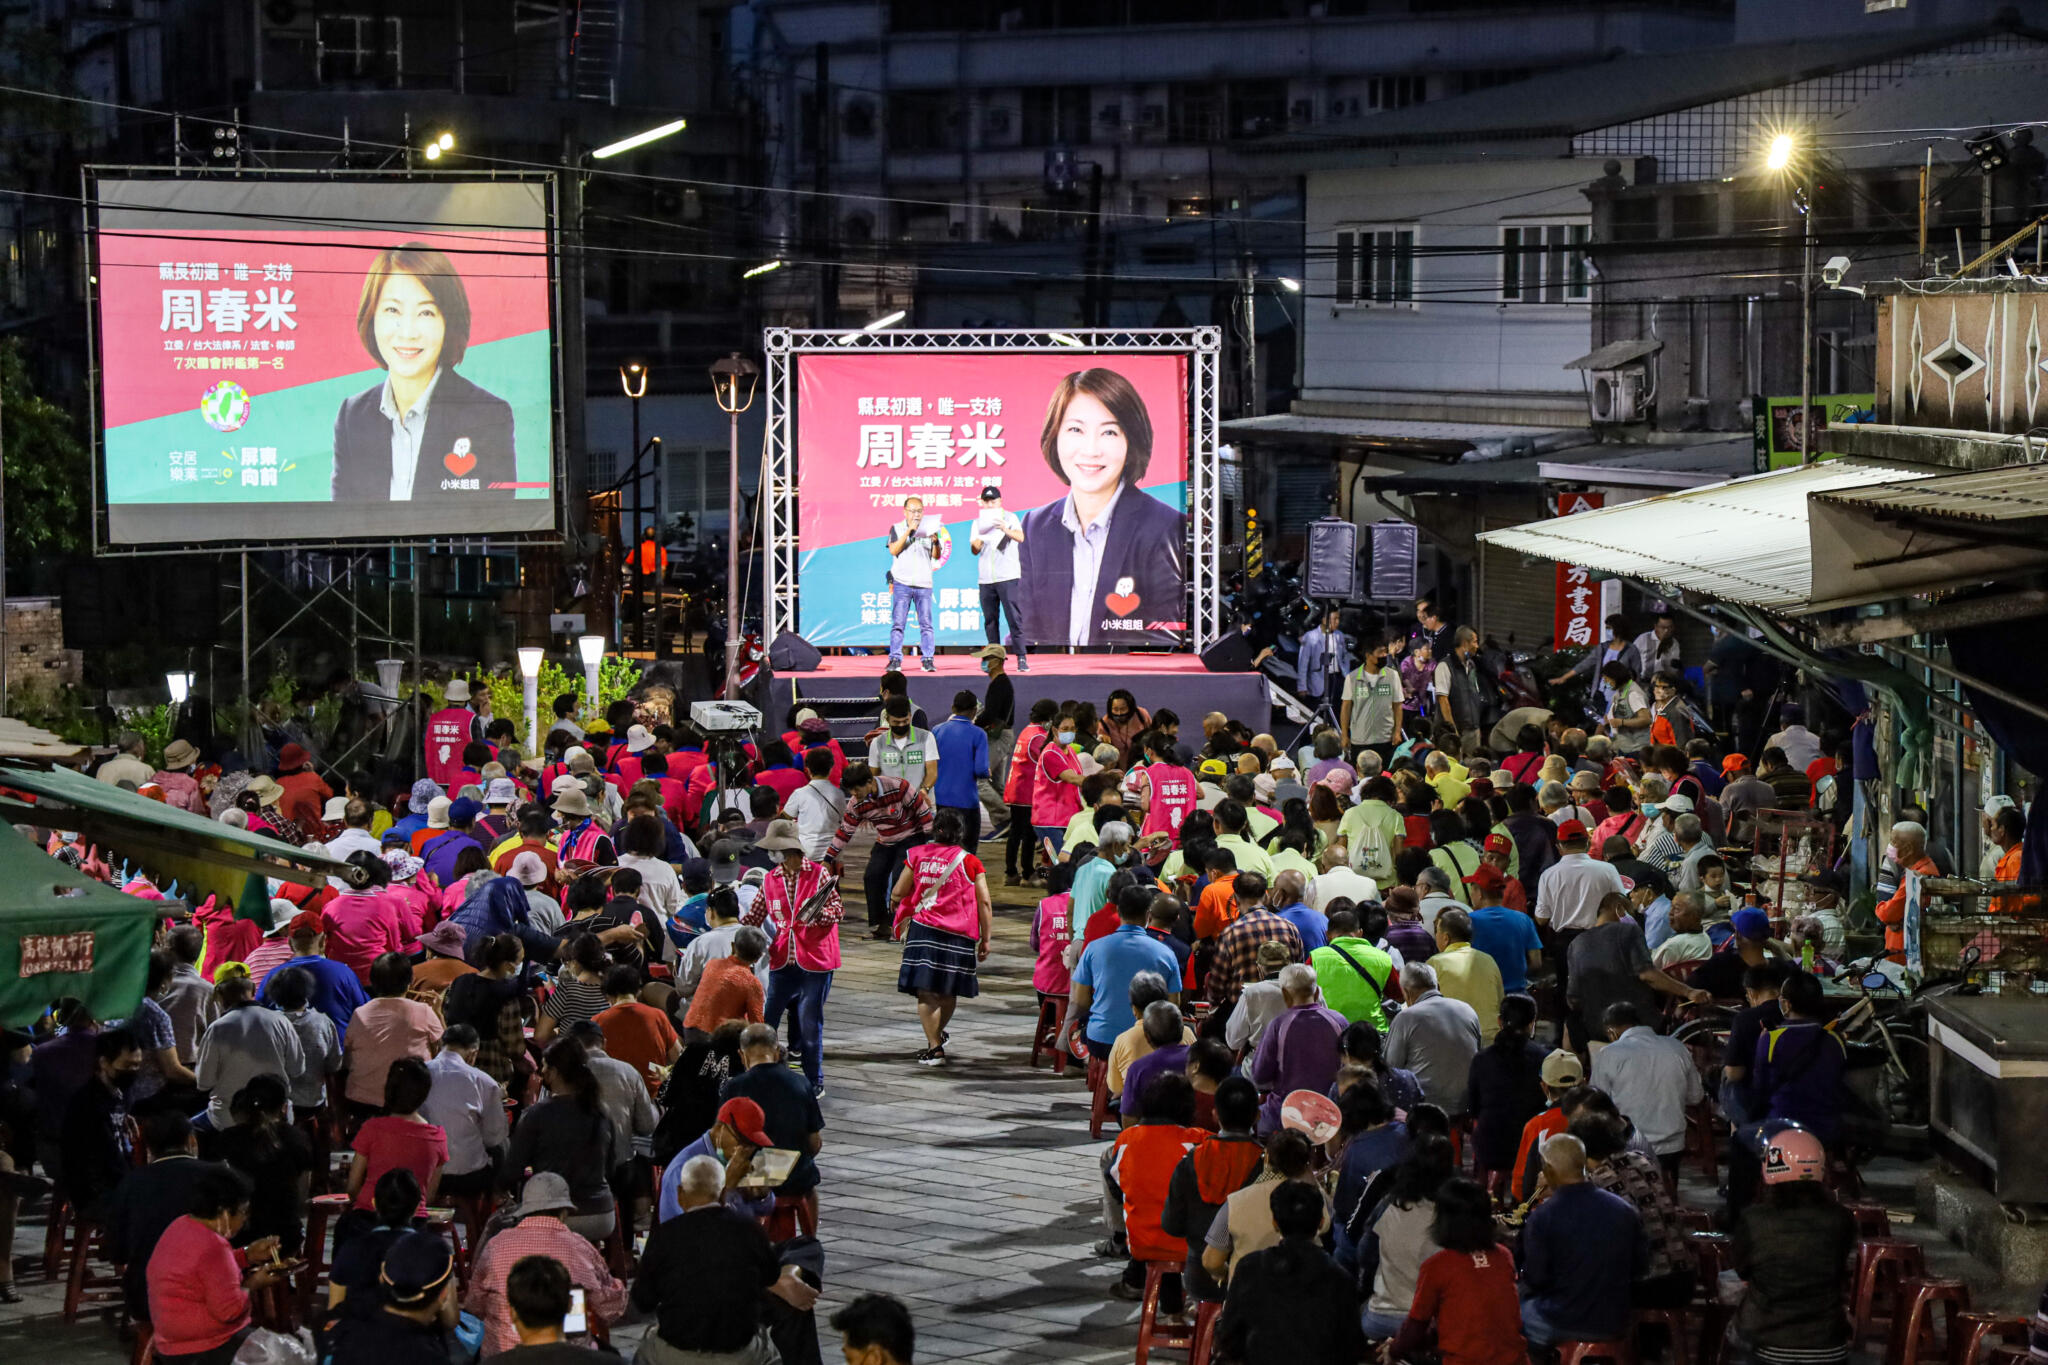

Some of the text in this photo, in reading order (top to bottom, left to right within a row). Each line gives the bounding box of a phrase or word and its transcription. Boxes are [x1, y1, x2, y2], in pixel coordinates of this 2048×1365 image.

[160, 287, 298, 332] 周春米
[856, 421, 1006, 469] 周春米
[169, 450, 197, 466] 安居
[241, 446, 277, 466] 屏東
[241, 466, 277, 487] 向前
[440, 479, 480, 490] 小米姐姐
[861, 592, 892, 608] 安居
[939, 588, 980, 609] 屏東
[939, 610, 980, 631] 向前
[1101, 619, 1143, 630] 小米姐姐
